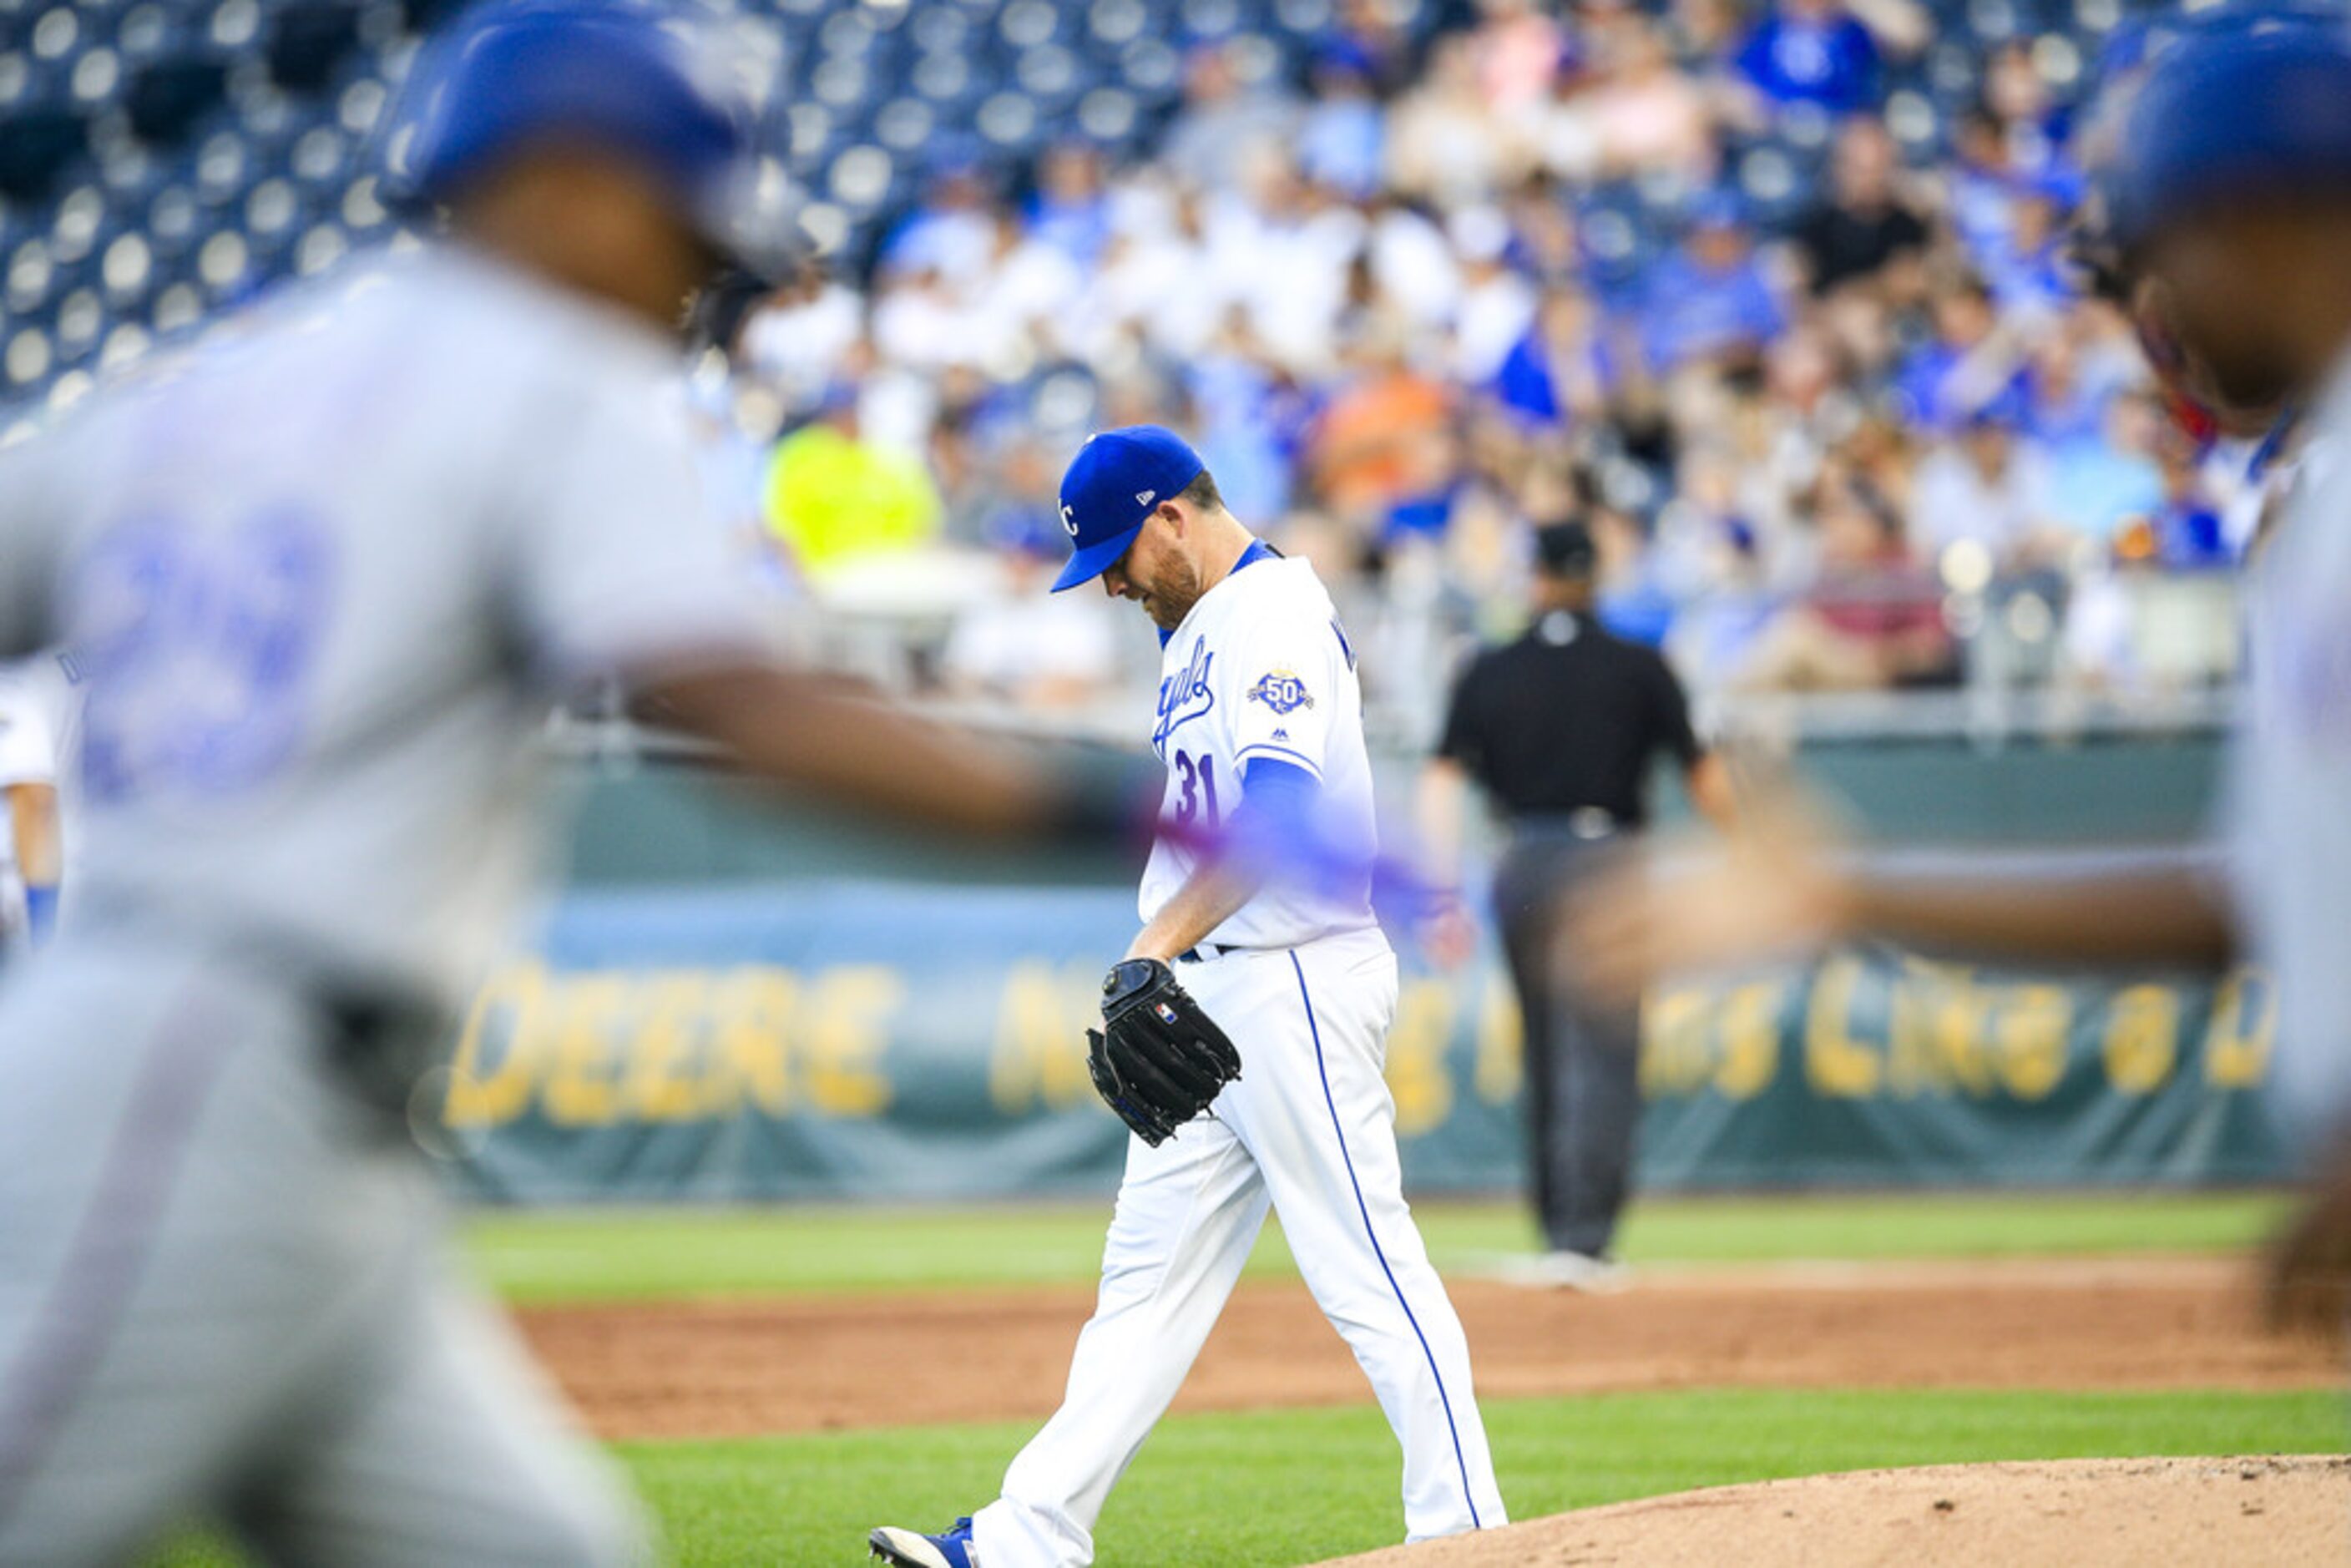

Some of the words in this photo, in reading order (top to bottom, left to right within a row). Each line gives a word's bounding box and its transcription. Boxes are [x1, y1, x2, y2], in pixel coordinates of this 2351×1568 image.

[1058, 498, 1079, 536] C
[1153, 634, 1215, 761] yals
[1266, 676, 1299, 704] 50
[1176, 748, 1220, 828] 31
[444, 960, 902, 1127] DEERE
